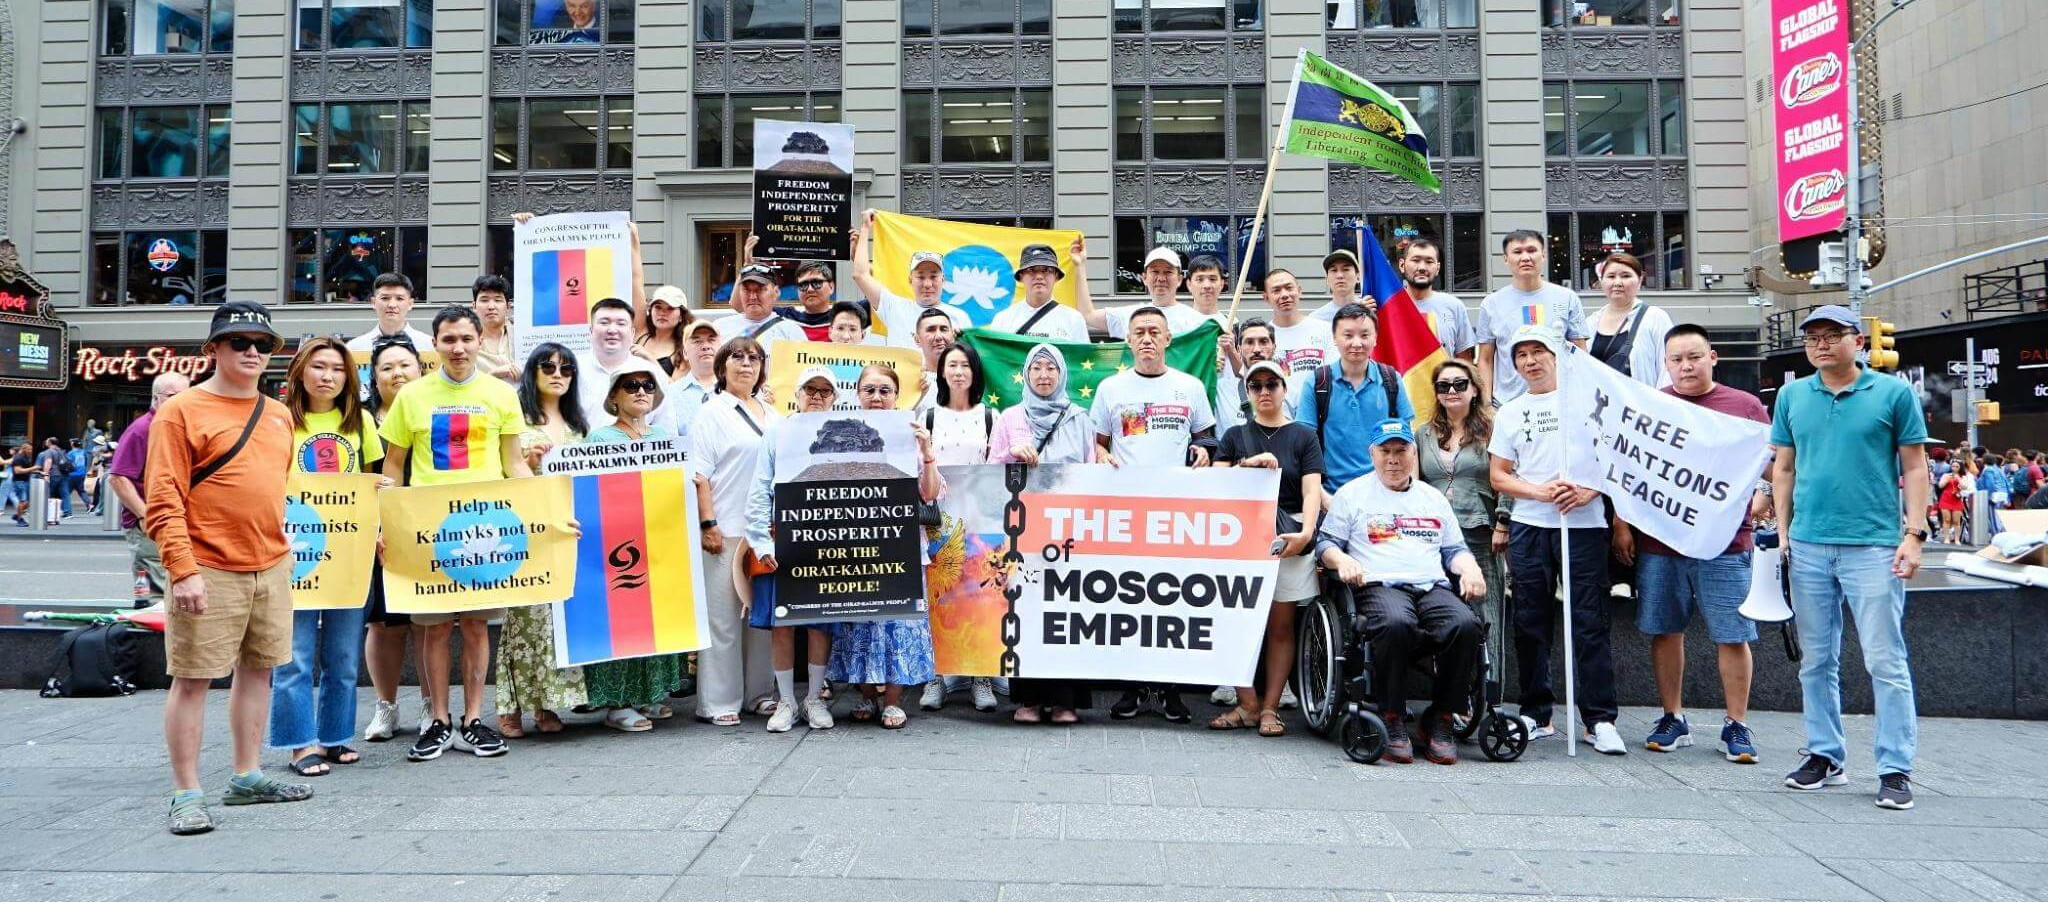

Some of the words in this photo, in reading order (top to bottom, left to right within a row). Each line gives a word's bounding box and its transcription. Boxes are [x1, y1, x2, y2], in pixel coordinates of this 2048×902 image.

[1780, 0, 1838, 36] GLOBAL
[1780, 15, 1838, 52] FLAGSHIP
[1781, 52, 1840, 107] Cane's
[1784, 113, 1842, 147] GLOBAL
[1299, 124, 1372, 146] Independent
[1404, 151, 1429, 171] Chin
[1785, 132, 1843, 163] FLAGSHIP
[1306, 140, 1368, 161] Liberating
[1375, 153, 1422, 179] Cantonia
[777, 179, 830, 190] FREEDOM
[1785, 169, 1844, 219] Cane's
[761, 190, 845, 202] INDEPENDENCE
[768, 202, 838, 213] PROSPERITY
[783, 214, 802, 222] FOR
[804, 215, 822, 223] THE
[534, 225, 578, 235] CONGRESS
[766, 224, 838, 234] OIRAT-KALMYK
[783, 234, 821, 242] PEOPLE!
[523, 235, 588, 246] OIRAT-KALMYK
[0, 291, 27, 312] Rock
[20, 332, 40, 345] NEW
[74, 347, 139, 381] Rock
[143, 346, 210, 382] Shop
[796, 352, 865, 367] Помогите
[1151, 407, 1166, 415] THE
[1151, 417, 1186, 425] MOSCOW
[1621, 406, 1690, 450] FREE
[561, 443, 627, 458] CONGRESS
[630, 442, 646, 453] OF
[650, 439, 675, 451] THE
[548, 454, 638, 473] OIRAT-KALMYK
[642, 452, 688, 465] PEOPLE
[1613, 433, 1730, 501] NATIONS
[300, 490, 357, 505] Putin!
[806, 486, 888, 500] FREEDOM
[1606, 463, 1699, 526] LEAGUE
[448, 499, 488, 516] Help
[493, 498, 512, 511] us
[781, 504, 914, 522] INDEPENDENCE
[416, 524, 494, 548] Kalmyks
[499, 523, 525, 538] not
[530, 520, 546, 534] to
[791, 525, 904, 542] PROSPERITY
[1044, 506, 1132, 544] THE
[1146, 509, 1243, 546] END
[818, 548, 847, 560] FOR
[850, 546, 880, 558] THE
[1042, 538, 1074, 562] of
[430, 552, 485, 573] perish
[489, 549, 530, 565] from
[791, 562, 906, 578] OIRAT-KALMYK
[415, 581, 467, 596] hands
[471, 570, 551, 592] butchers!
[819, 581, 880, 594] PEOPLE!
[1044, 568, 1264, 609] MOSCOW
[1043, 611, 1213, 651] EMPIRE
